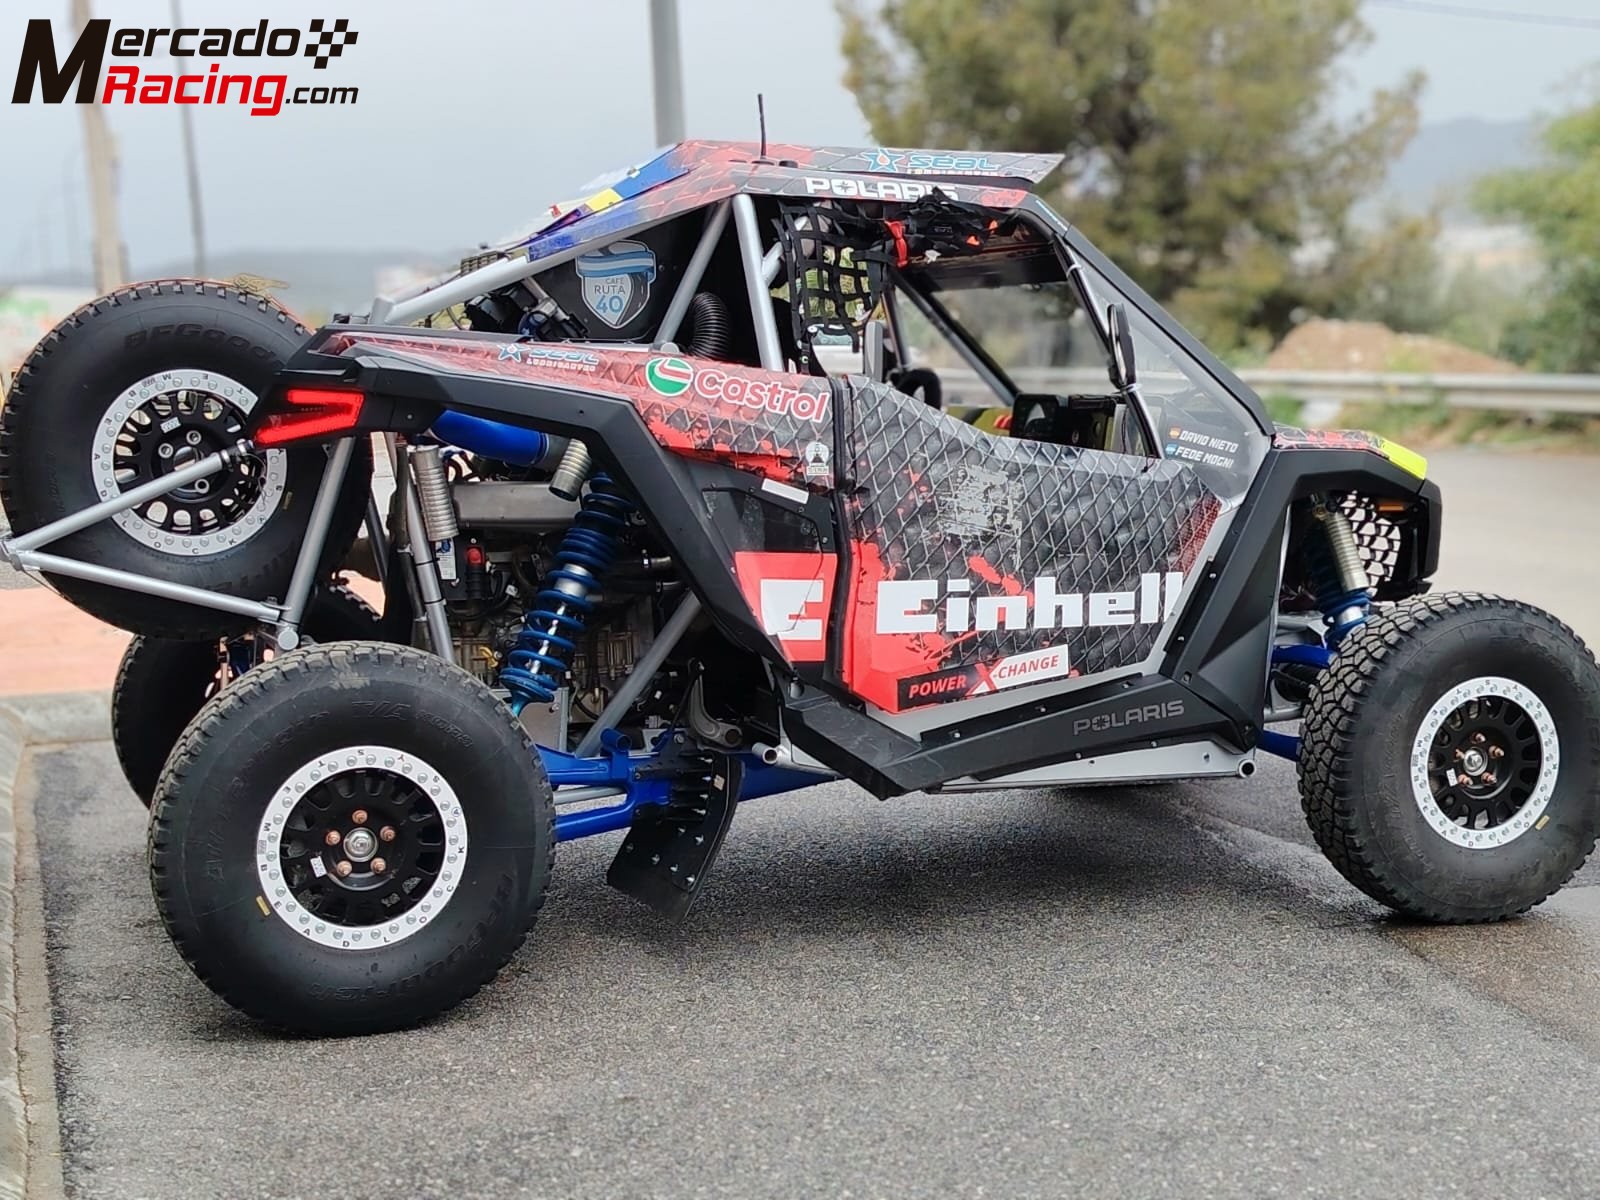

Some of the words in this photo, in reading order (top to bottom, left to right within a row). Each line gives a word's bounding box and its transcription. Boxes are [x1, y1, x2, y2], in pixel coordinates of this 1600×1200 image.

[805, 176, 960, 203] POLARIS
[594, 285, 626, 295] RUTA
[595, 295, 624, 313] 40
[695, 368, 830, 423] Castrol
[1179, 430, 1209, 446] DAVID
[1208, 438, 1239, 453] NIETO
[1175, 446, 1203, 462] FEDE
[1202, 453, 1234, 469] MOGNI
[877, 572, 1184, 634] Einhell
[908, 674, 968, 700] POWER
[1073, 699, 1185, 736] POLARIS
